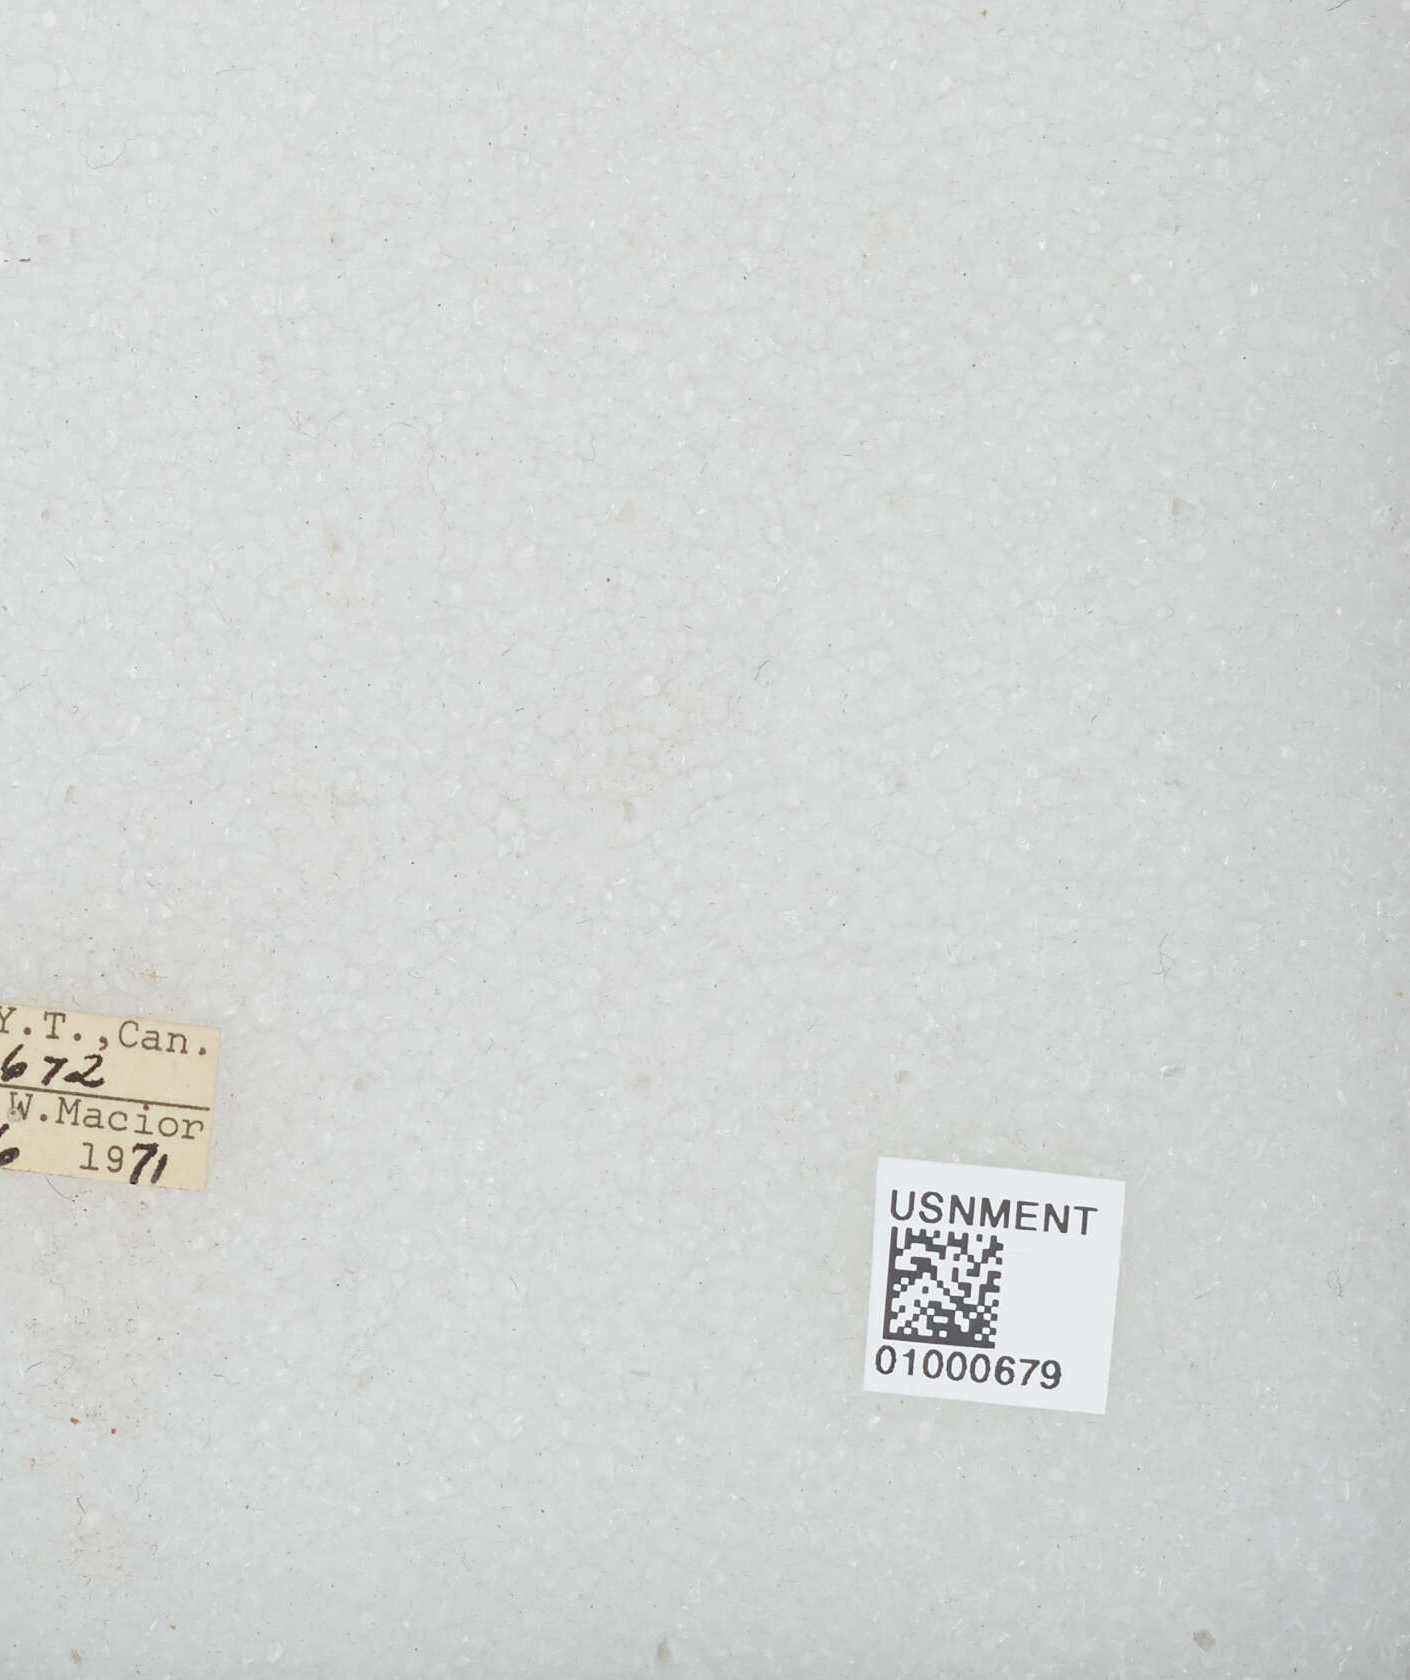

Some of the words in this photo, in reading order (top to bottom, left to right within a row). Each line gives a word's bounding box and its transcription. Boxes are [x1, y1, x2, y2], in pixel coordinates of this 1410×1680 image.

[79, 1142, 168, 1185] 1971
[890, 1189, 1098, 1235] USNMENT
[875, 1345, 1062, 1389] 01000679
